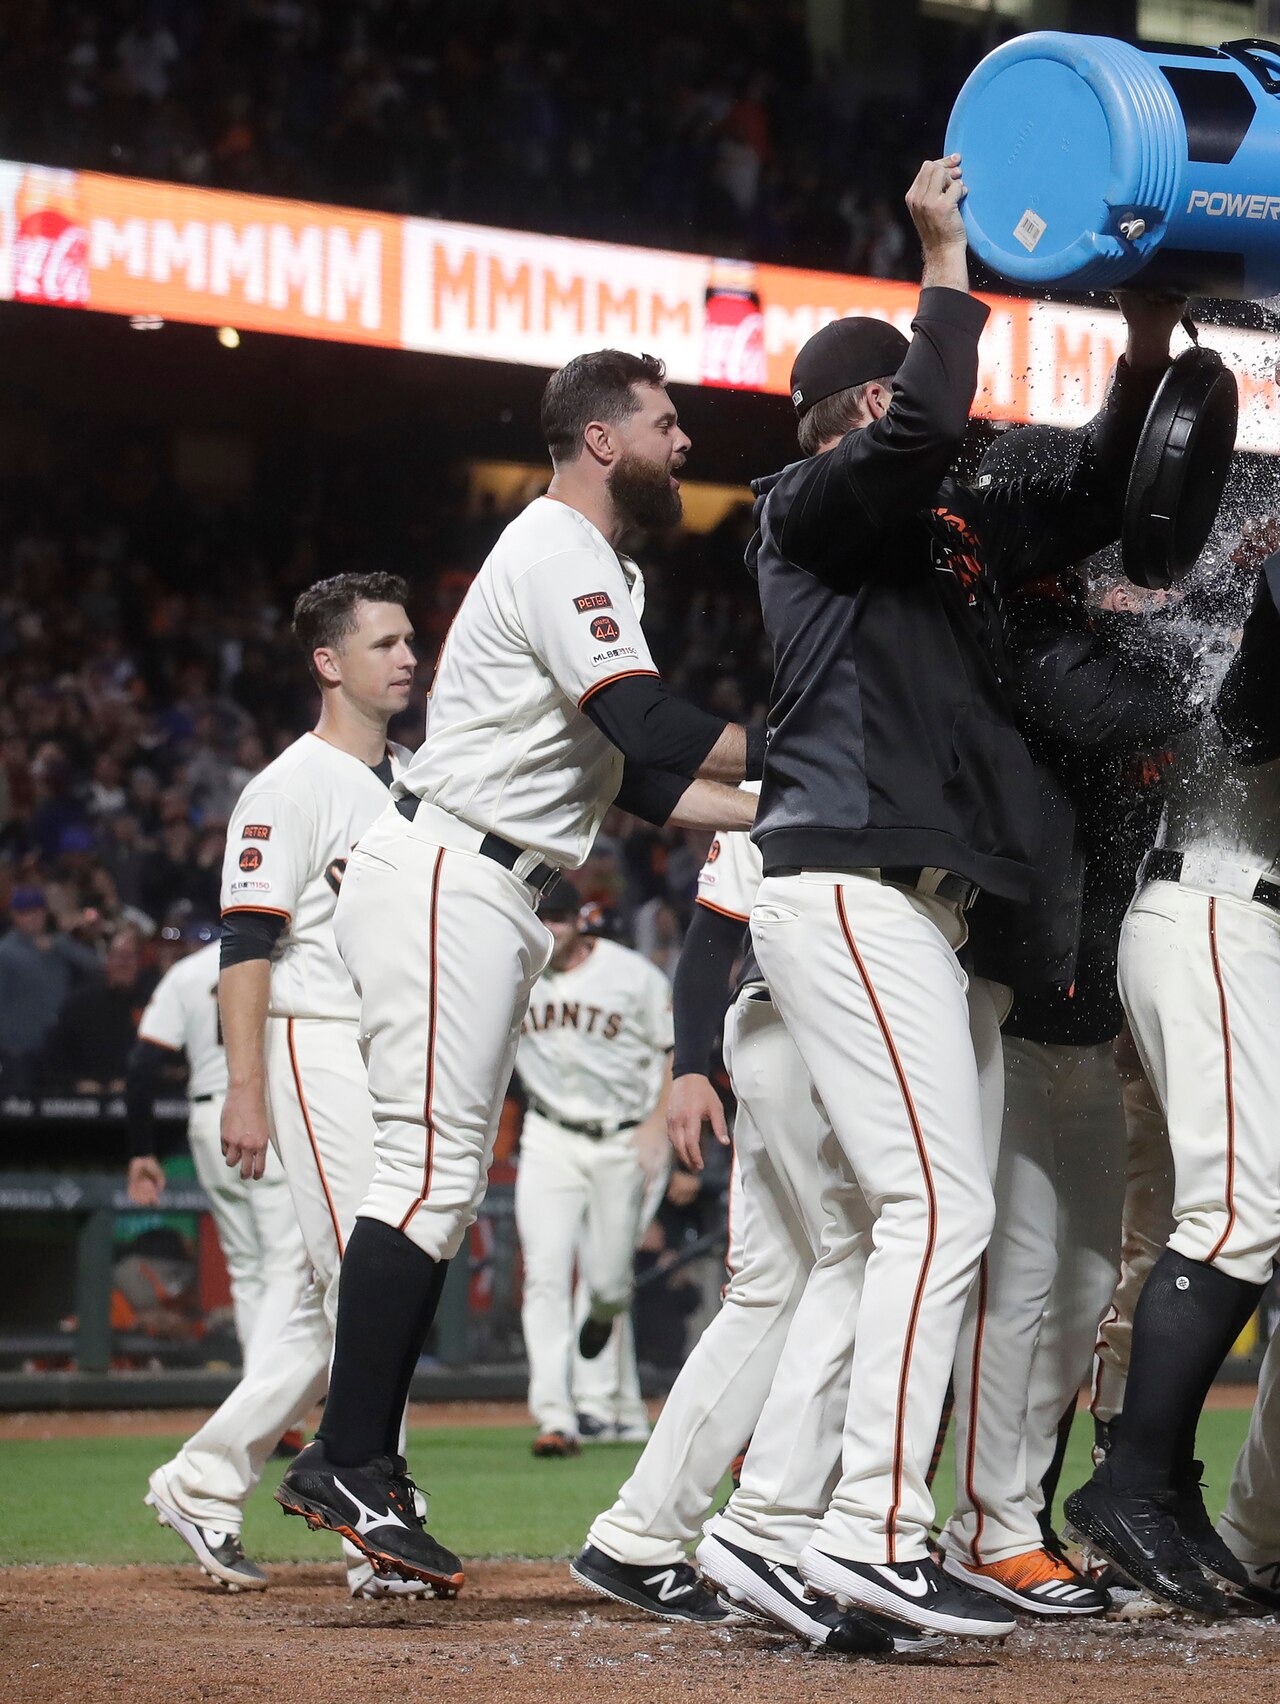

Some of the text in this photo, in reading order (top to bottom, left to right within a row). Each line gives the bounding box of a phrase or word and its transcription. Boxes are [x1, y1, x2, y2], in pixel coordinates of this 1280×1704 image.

[90, 217, 382, 330] MMMMM
[432, 242, 691, 336] MMMMM
[577, 594, 608, 610] PETER
[243, 826, 269, 838] PETER
[240, 855, 259, 869] 44
